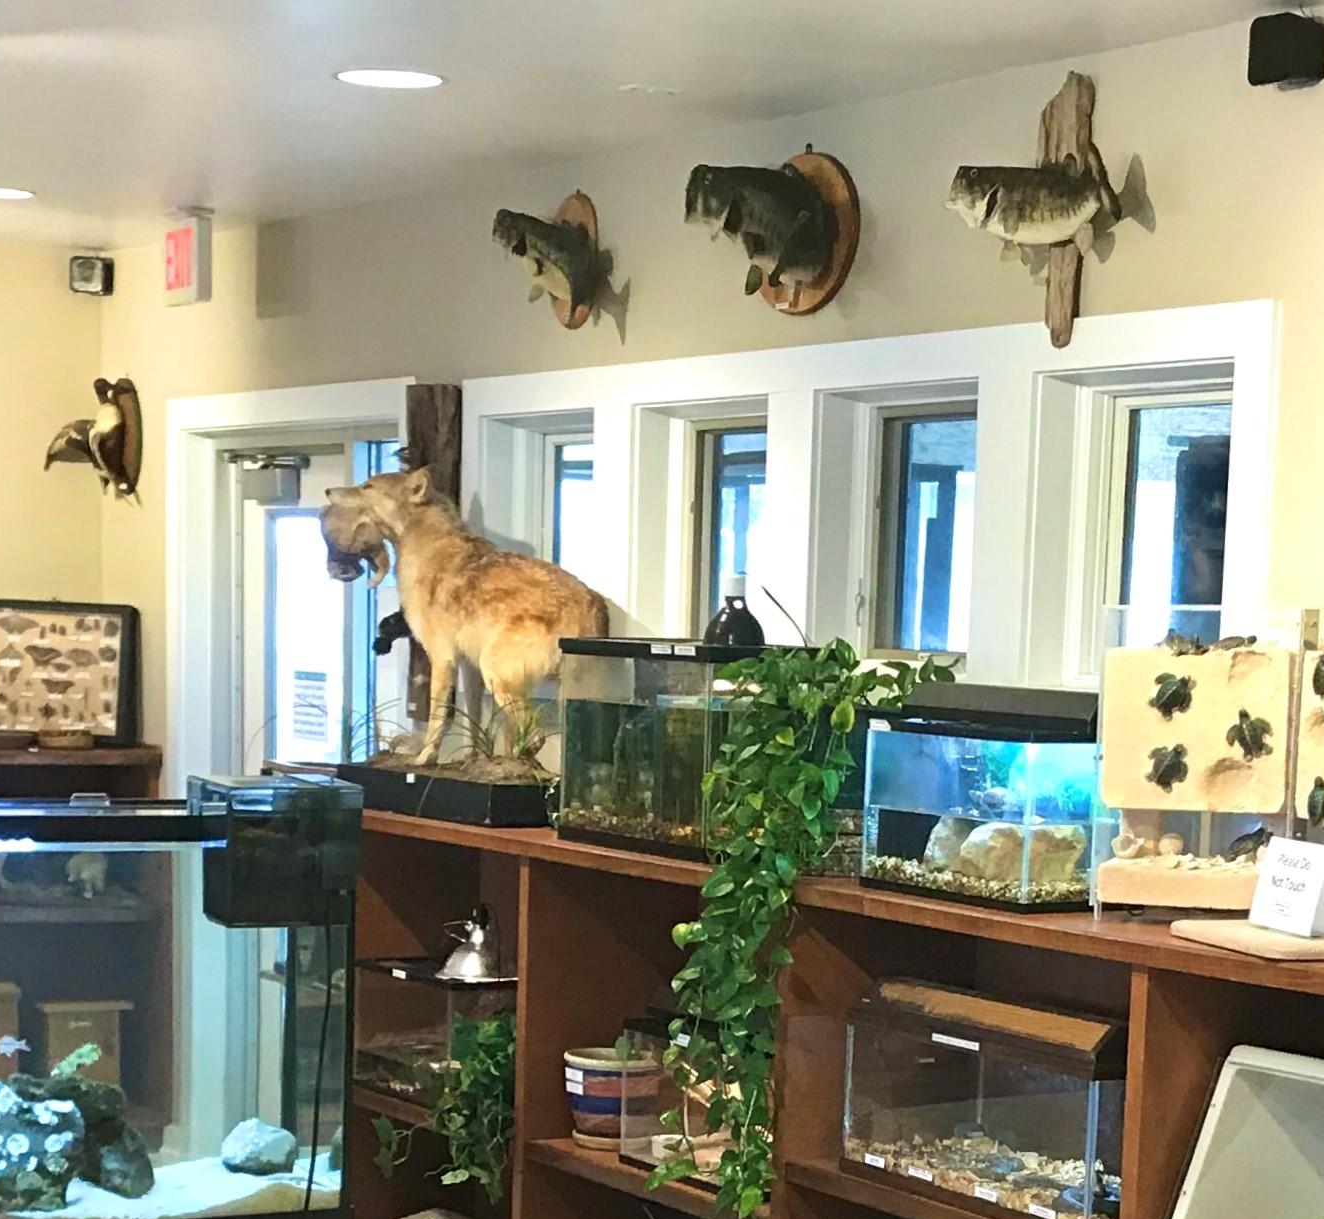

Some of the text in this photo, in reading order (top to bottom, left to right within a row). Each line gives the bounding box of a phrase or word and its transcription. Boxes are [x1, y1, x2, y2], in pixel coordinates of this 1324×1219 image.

[1278, 853, 1312, 871] Please Do
[1271, 875, 1307, 893] Not Touch
